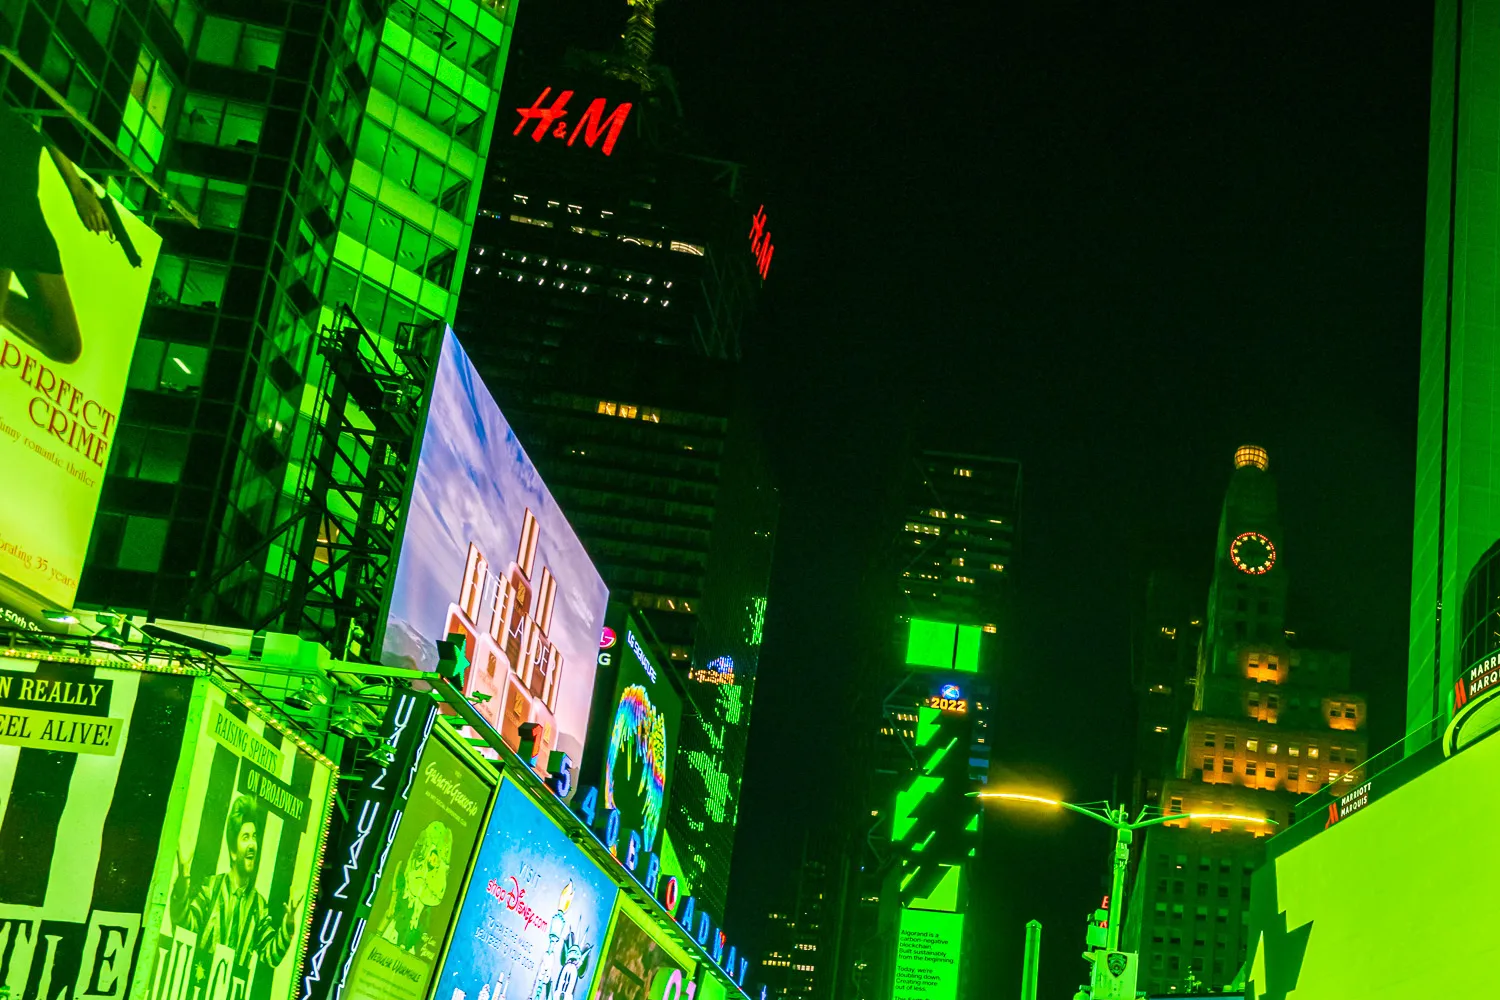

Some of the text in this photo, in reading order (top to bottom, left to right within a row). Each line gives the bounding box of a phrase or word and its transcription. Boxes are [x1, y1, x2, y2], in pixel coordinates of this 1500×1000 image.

[513, 86, 633, 156] H&M
[748, 204, 774, 280] H&M
[0, 339, 116, 438] PERFECT
[28, 396, 108, 468] CRIME
[23, 436, 64, 468] romantic
[66, 461, 96, 488] thriller
[35, 556, 48, 571] 35
[5, 609, 27, 628] 50th
[18, 677, 104, 707] REALLY
[930, 697, 967, 712] 2022
[40, 719, 114, 746] ALIVE!
[214, 712, 278, 774] RAISING SPIRITS
[247, 769, 304, 821] ON BROADWAY!
[1340, 795, 1368, 817] MARQUIS
[1341, 782, 1372, 806] MARRIOTT
